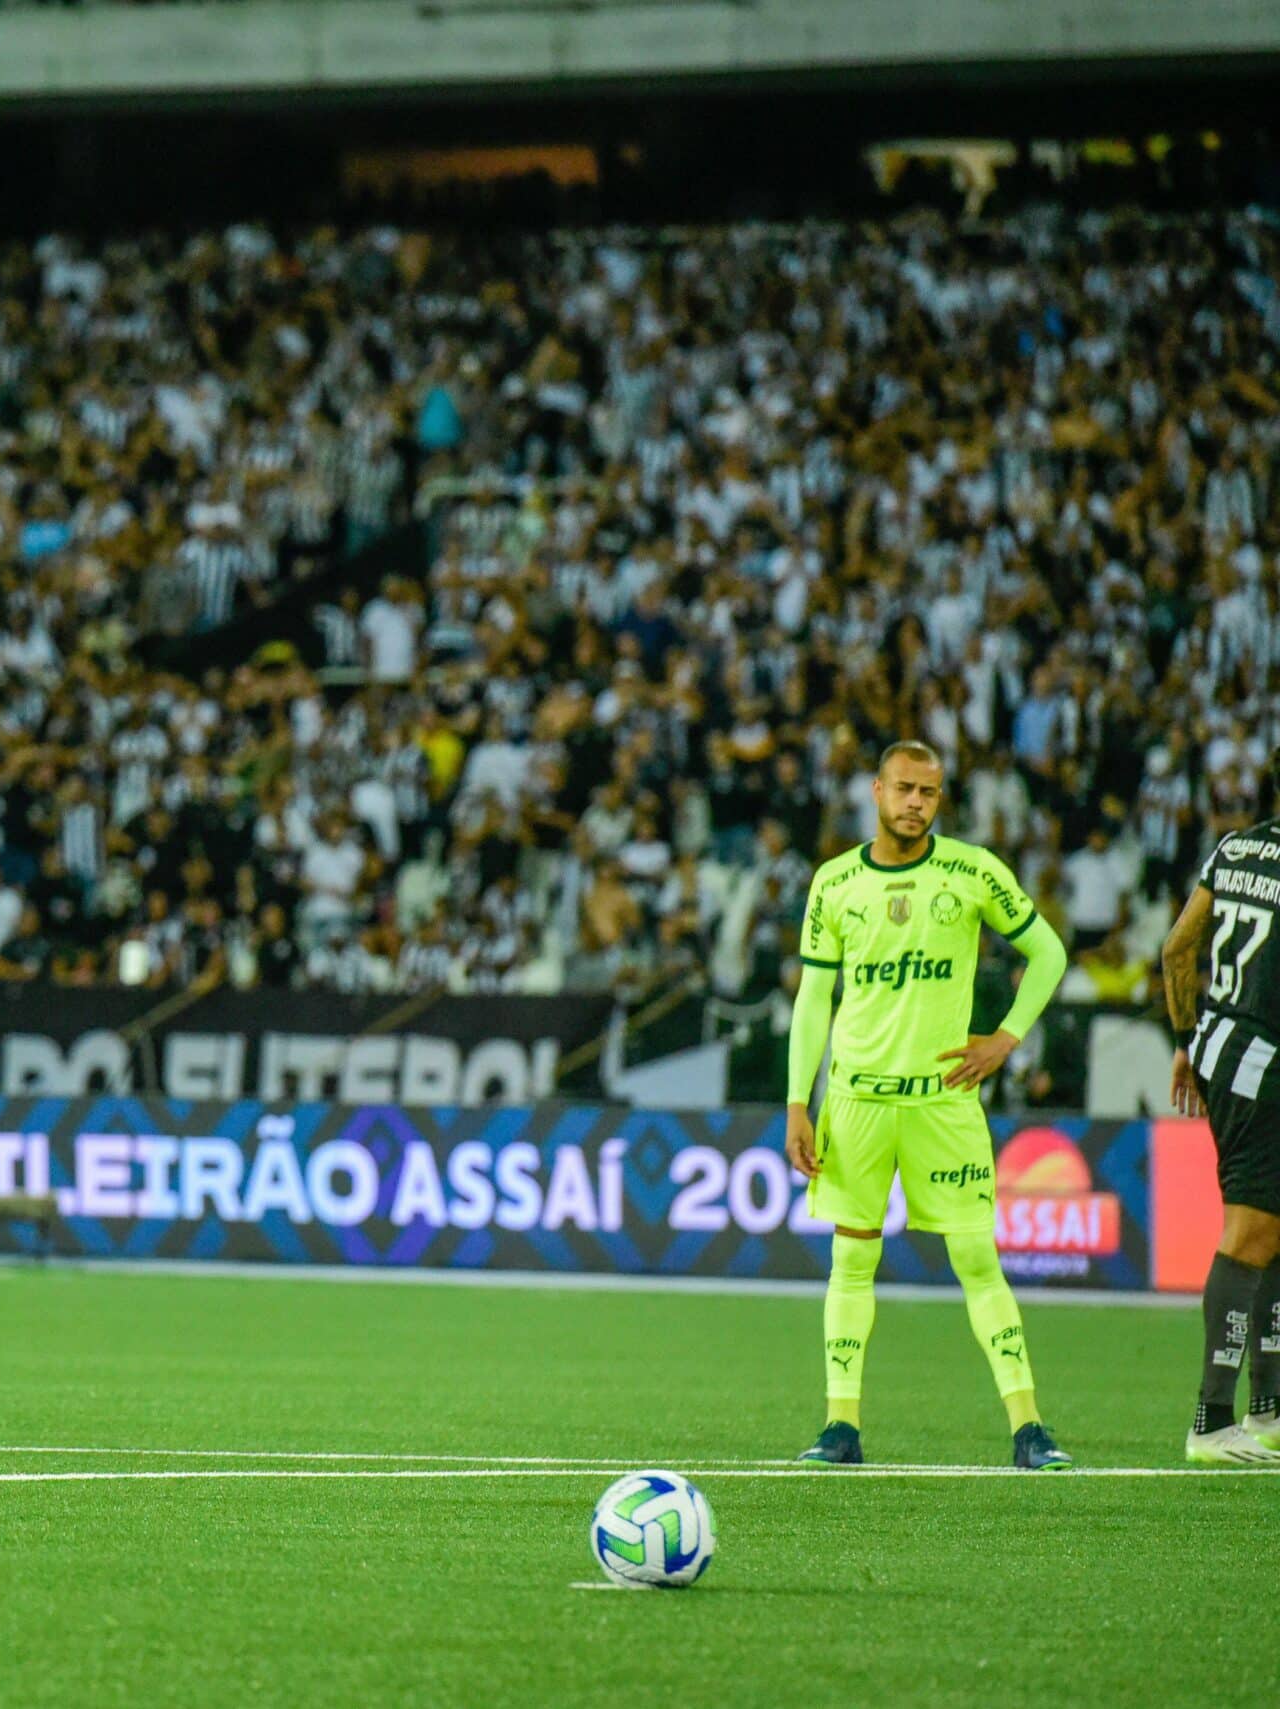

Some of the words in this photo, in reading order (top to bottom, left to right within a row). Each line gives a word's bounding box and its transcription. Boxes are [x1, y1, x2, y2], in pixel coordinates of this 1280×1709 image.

[928, 856, 978, 877] crefisa
[981, 871, 1019, 921] crefisa
[810, 895, 824, 950] crefisa
[855, 950, 953, 991] crefisa
[1208, 898, 1274, 1006] 77
[390, 1137, 629, 1232] ASSAÍ
[930, 1163, 991, 1188] crefisa
